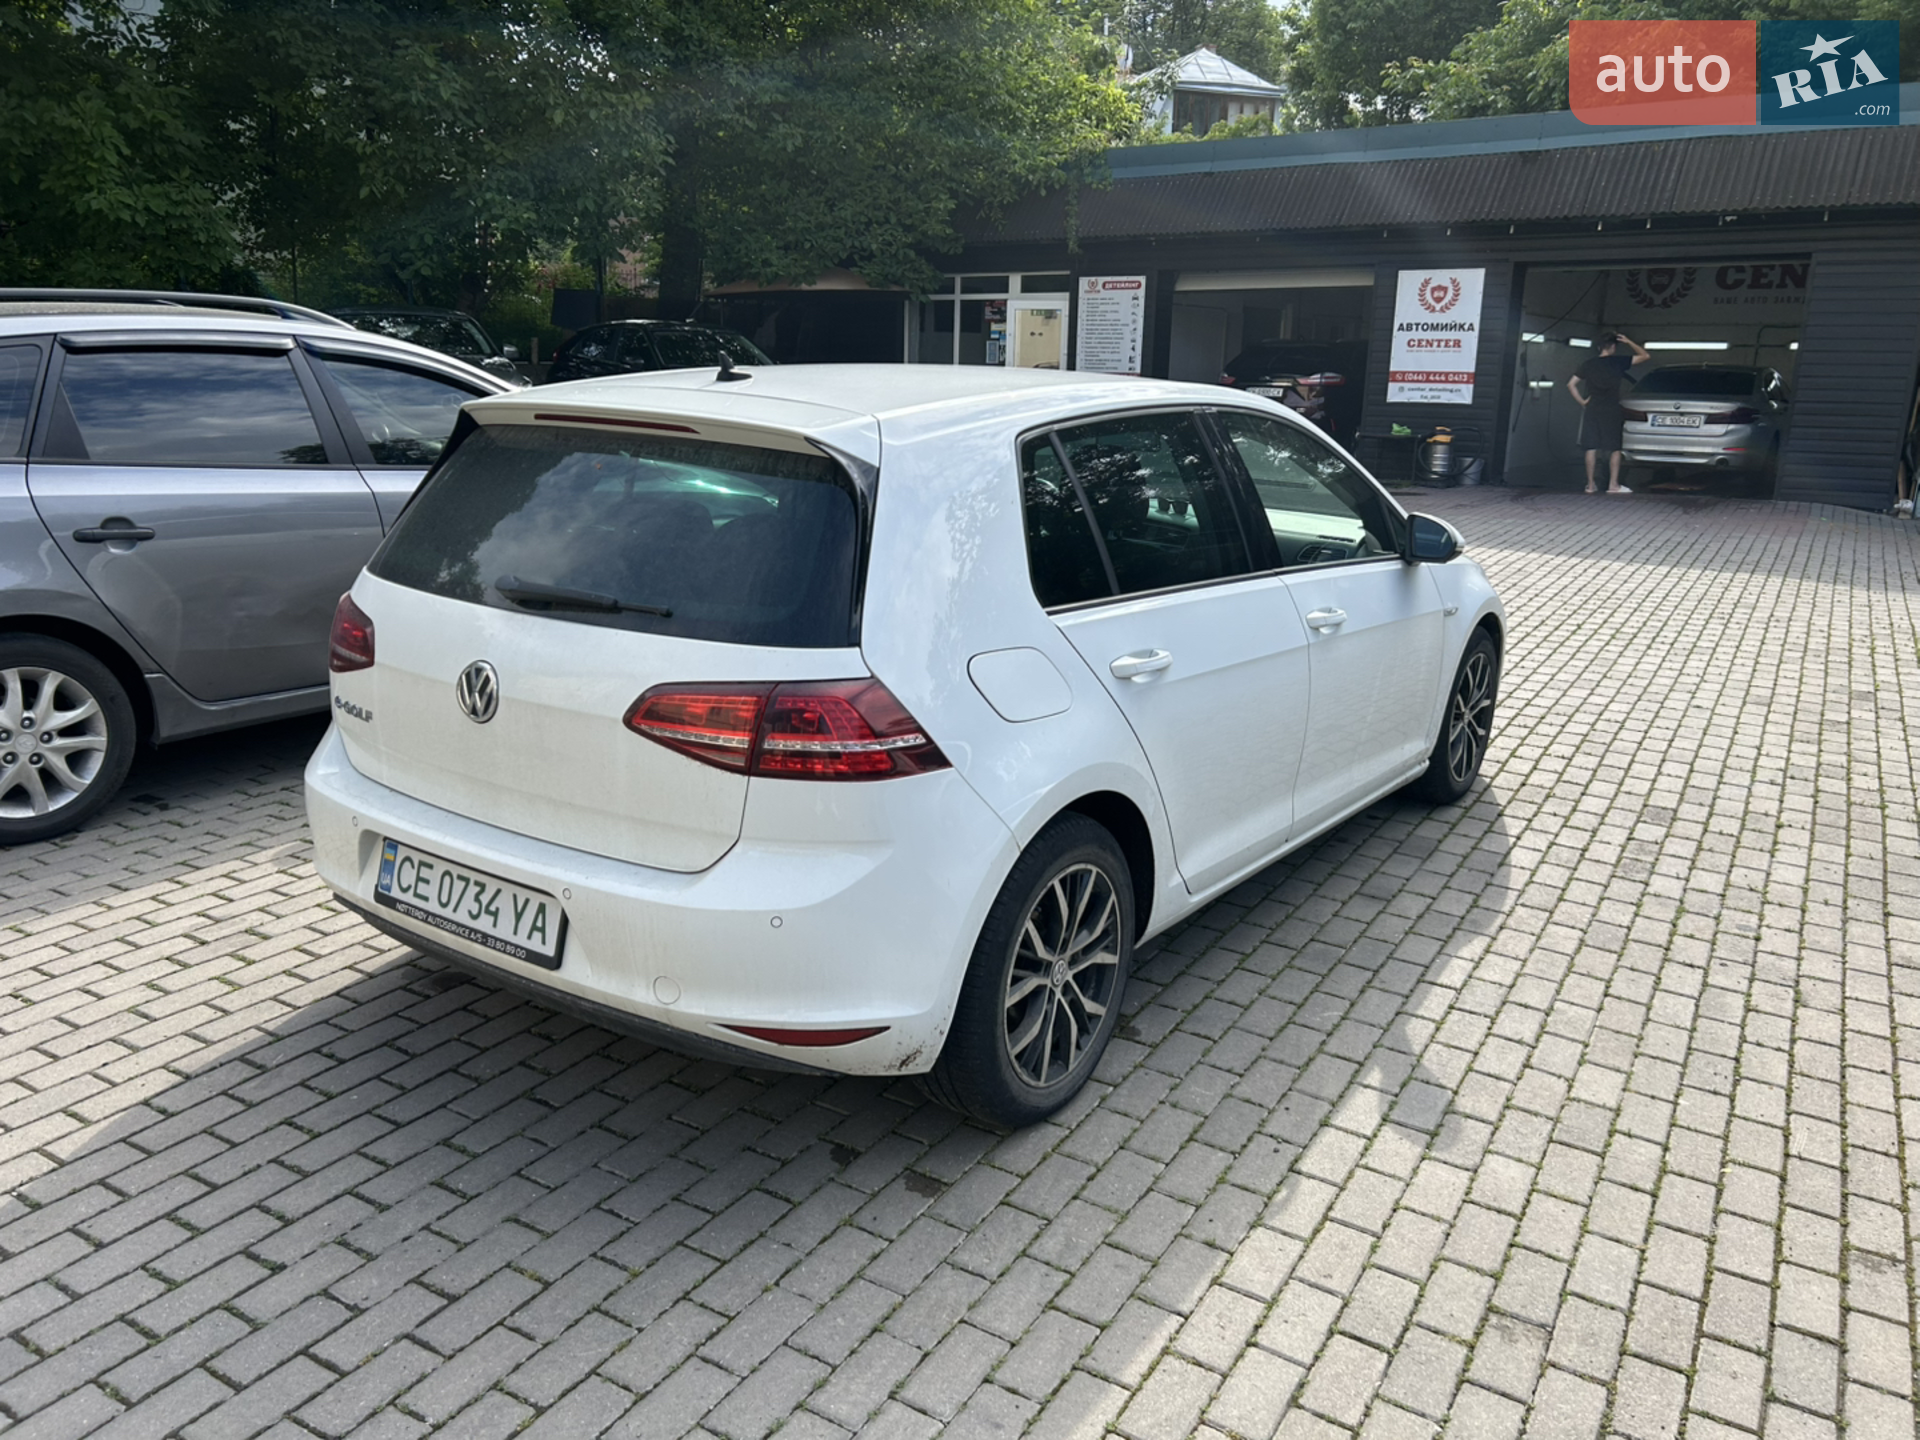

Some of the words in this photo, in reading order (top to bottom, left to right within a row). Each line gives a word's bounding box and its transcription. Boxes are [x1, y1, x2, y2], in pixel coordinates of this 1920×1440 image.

[1743, 296, 1768, 304] АВТО
[1397, 321, 1475, 332] АВТОМИЙКА
[1407, 339, 1462, 348] CENTER
[334, 695, 373, 723] e-GOLF
[380, 872, 392, 885] UA
[397, 855, 434, 902] CE
[437, 869, 503, 929] 0734
[513, 893, 547, 946] YA
[427, 914, 470, 938] AUTOSERVICE
[470, 930, 483, 943] A/S
